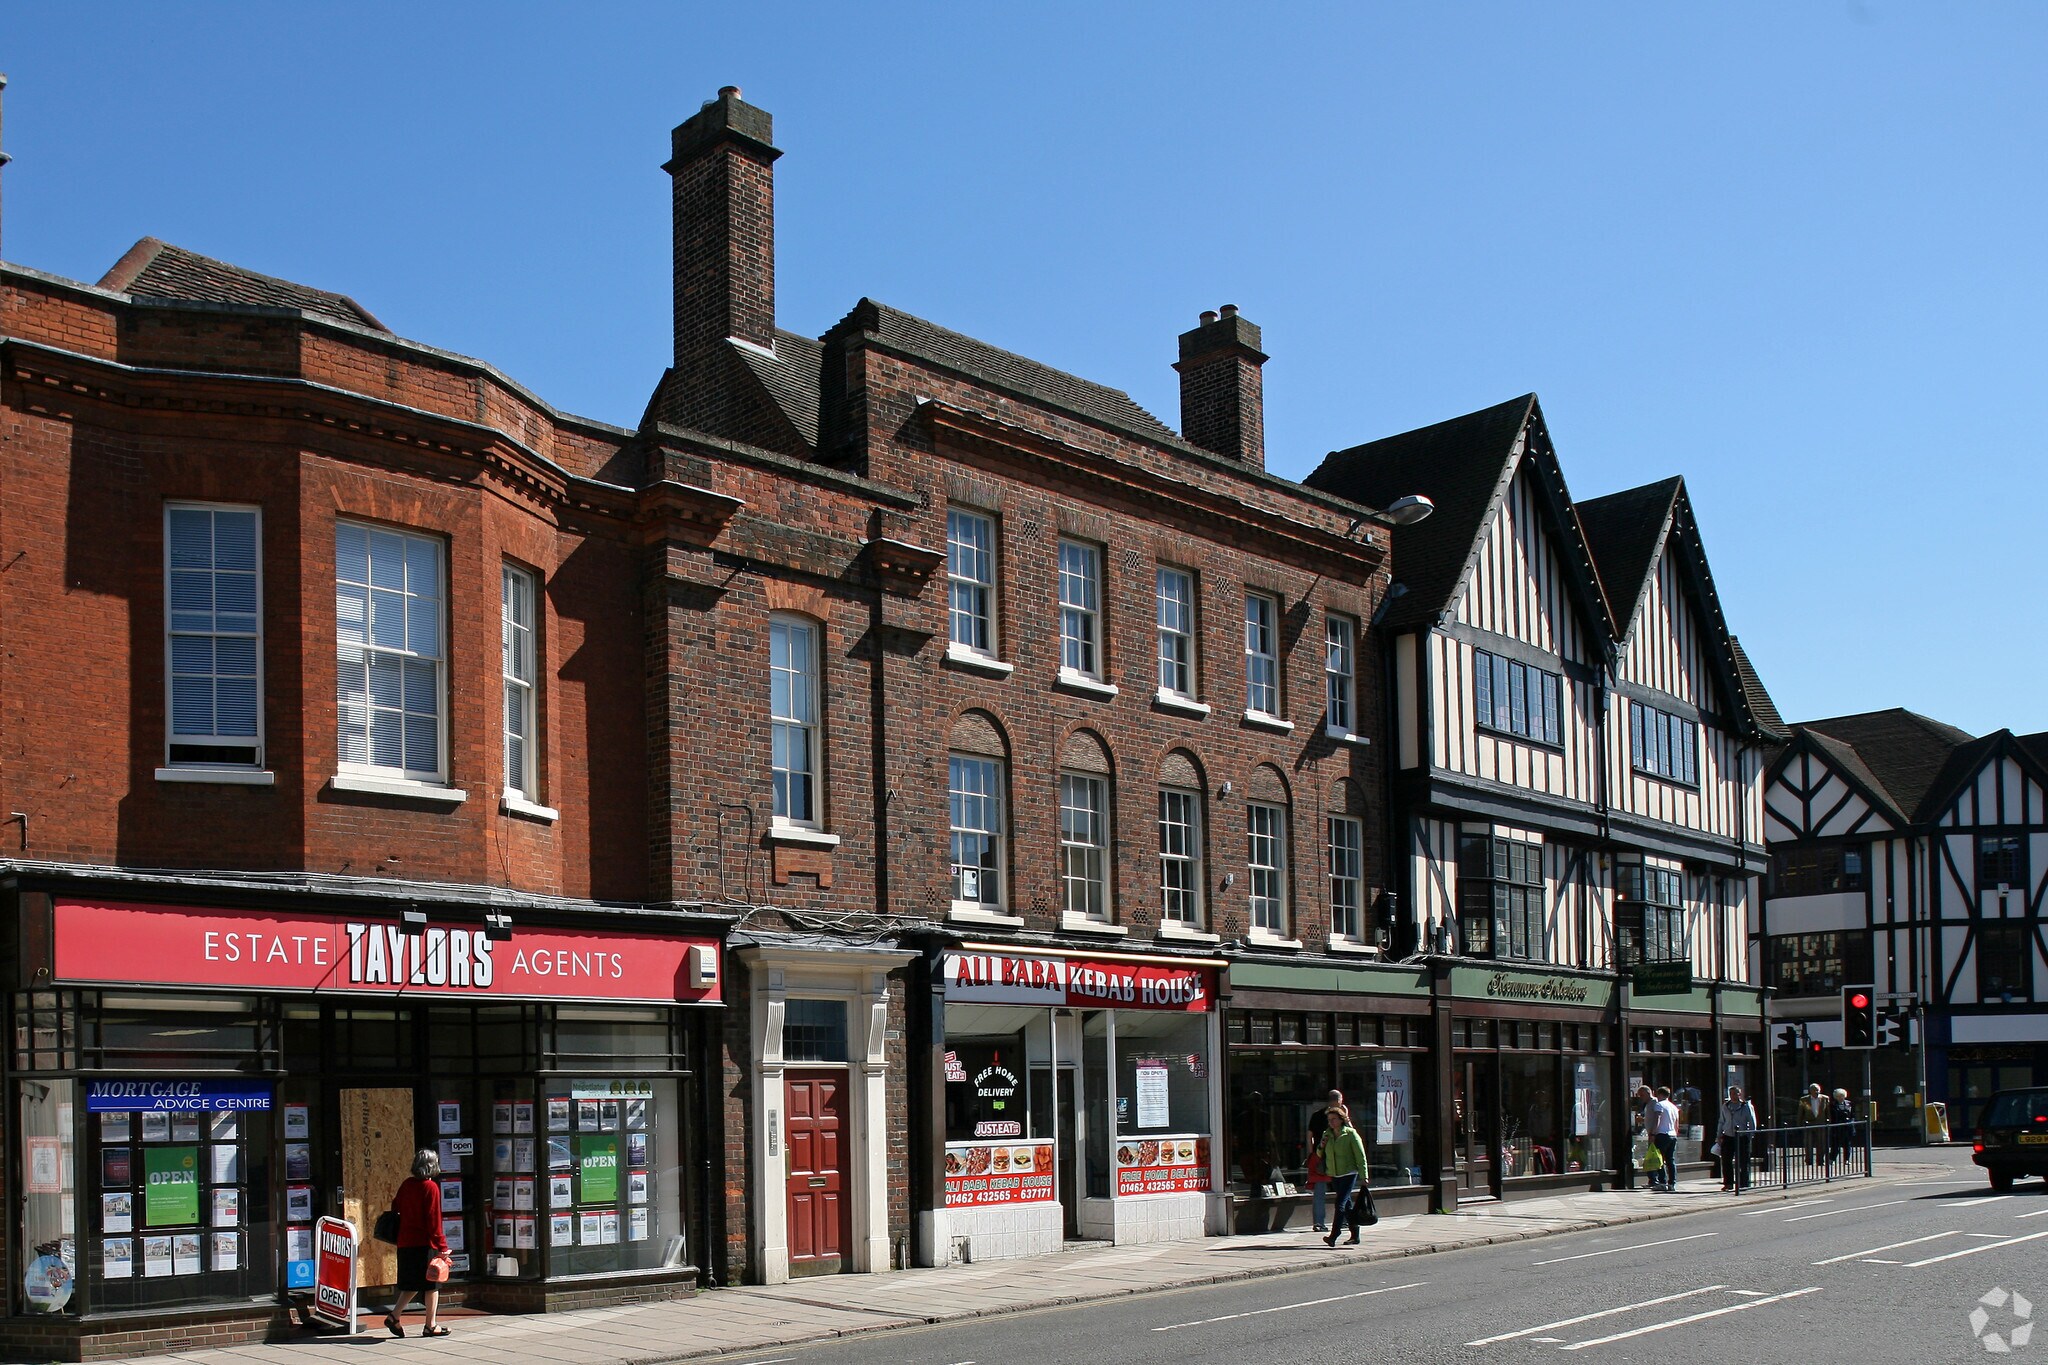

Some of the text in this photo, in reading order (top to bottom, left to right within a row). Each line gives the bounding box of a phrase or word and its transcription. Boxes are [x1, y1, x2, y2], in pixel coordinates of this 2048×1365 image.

[204, 922, 622, 987] ESTATE TAYLORS AGENTS
[956, 956, 1205, 1005] ALI BABA KEBAB HOUSE
[974, 1066, 1019, 1088] FREE HOME
[1381, 1074, 1403, 1088] 2 Years
[91, 1081, 201, 1098] MORTGAGE
[977, 1088, 1014, 1097] DELIVERY
[153, 1098, 270, 1109] ADVICE CENTRE
[1384, 1089, 1406, 1126] 0%
[977, 1124, 998, 1135] JUST
[998, 1123, 1014, 1134] EAT
[453, 1142, 472, 1150] open
[583, 1156, 616, 1168] OPEN
[149, 1171, 195, 1185] OPEN
[1120, 1167, 1209, 1182] FREE HOME DELIVERY
[945, 1174, 1052, 1192] ALI BABA KEBAB HOUSE
[1120, 1183, 1144, 1193] 01462
[1147, 1181, 1175, 1191] 432565
[1183, 1179, 1209, 1189] 637171
[945, 1192, 973, 1205] 01462
[976, 1191, 1010, 1202] 432565
[1021, 1188, 1051, 1199] 637171
[322, 1230, 351, 1258] TAYLORS
[321, 1287, 345, 1307] OPEN
